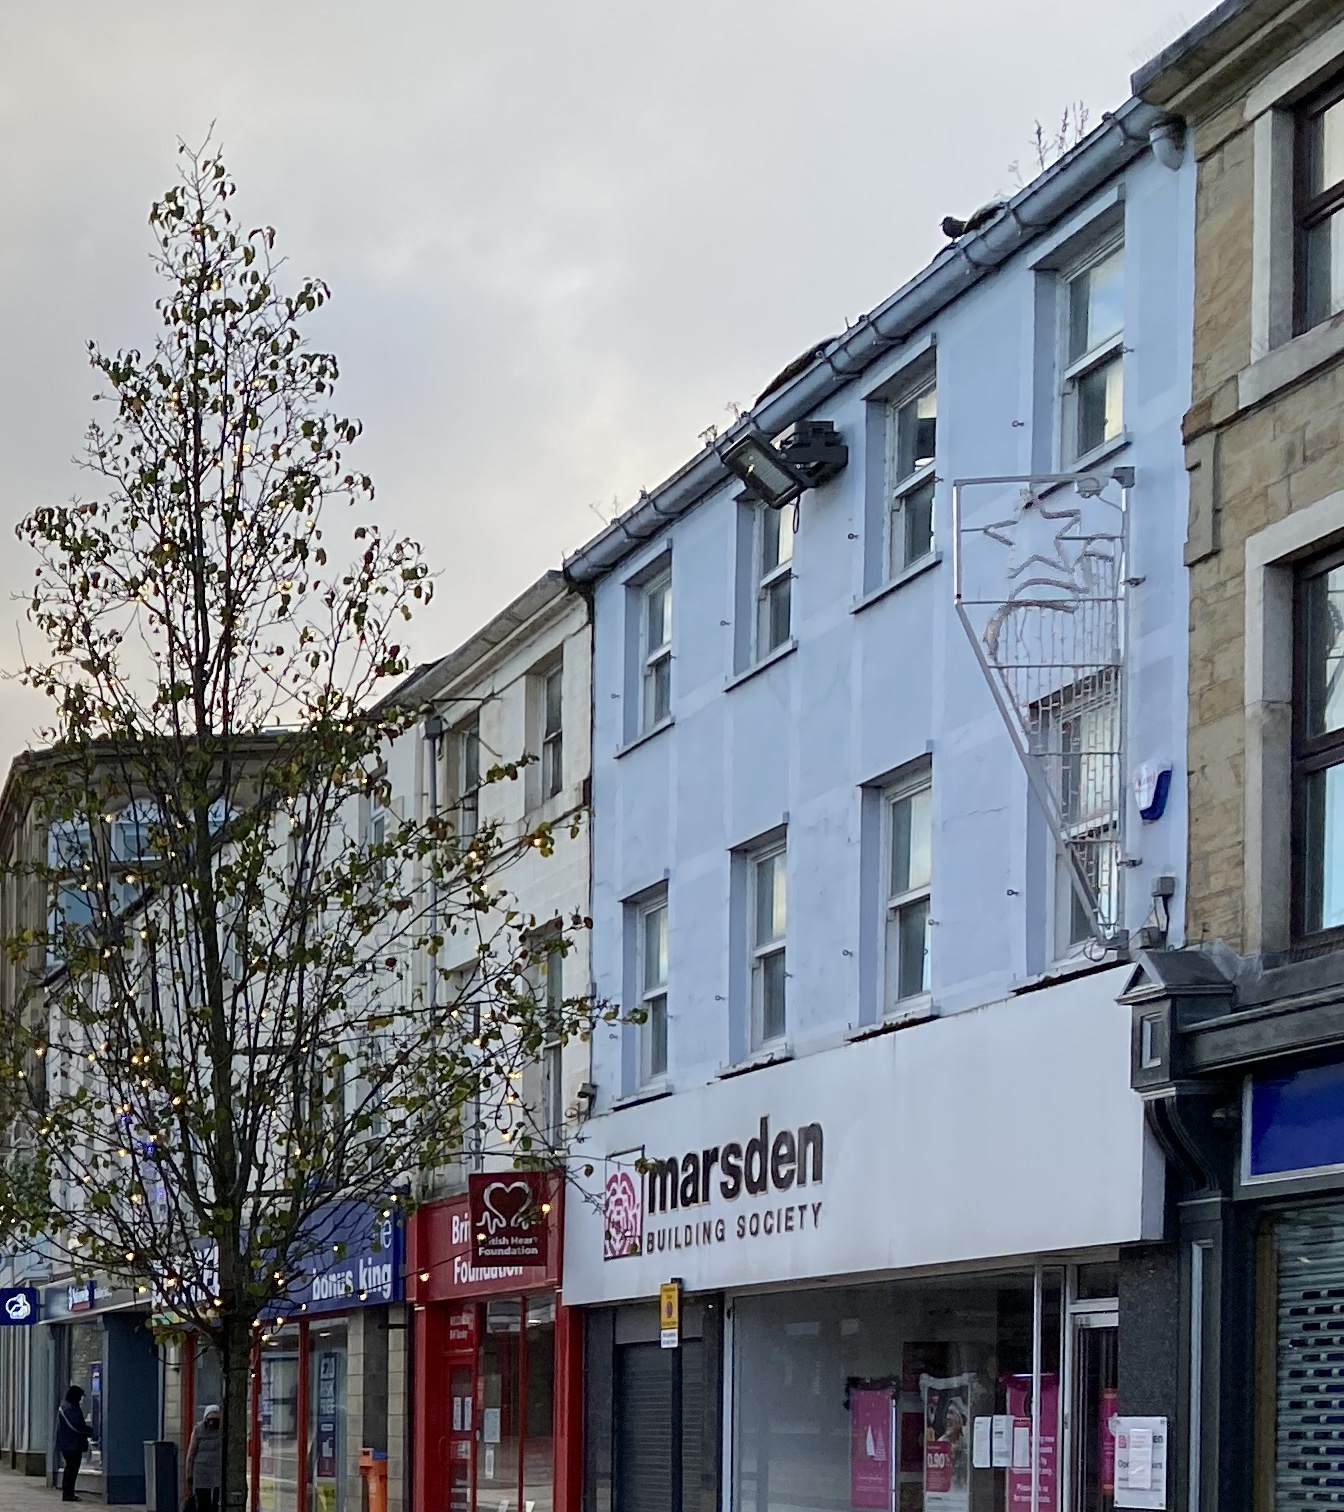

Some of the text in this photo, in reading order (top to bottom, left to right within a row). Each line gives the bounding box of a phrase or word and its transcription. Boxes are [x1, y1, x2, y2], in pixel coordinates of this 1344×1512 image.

[648, 1114, 824, 1217] marsden
[478, 1246, 539, 1257] Foundation
[646, 1201, 823, 1255] BUILDING SOCIETY
[312, 1256, 392, 1301] bonus king
